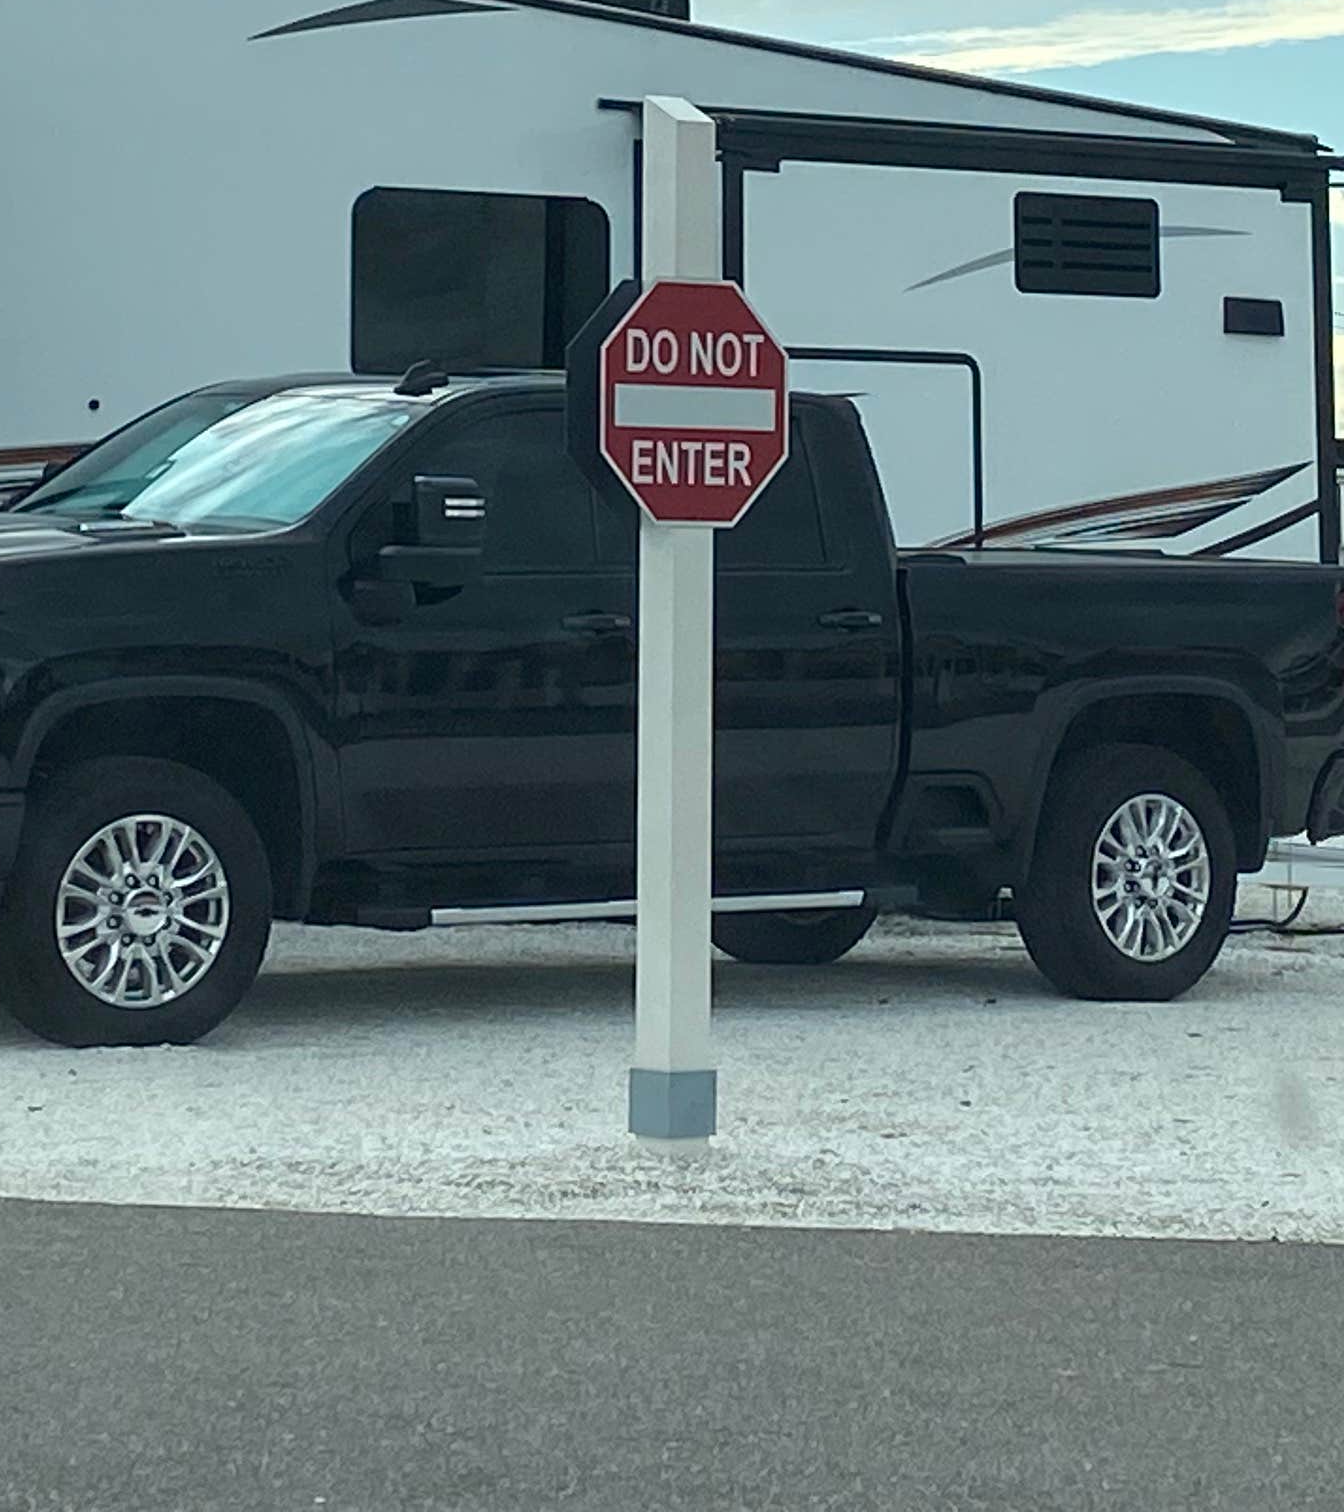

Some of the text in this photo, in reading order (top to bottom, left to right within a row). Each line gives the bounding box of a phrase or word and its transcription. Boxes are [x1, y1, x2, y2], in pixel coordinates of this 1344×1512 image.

[626, 328, 765, 378] DO NOT
[631, 439, 752, 487] ENTER
